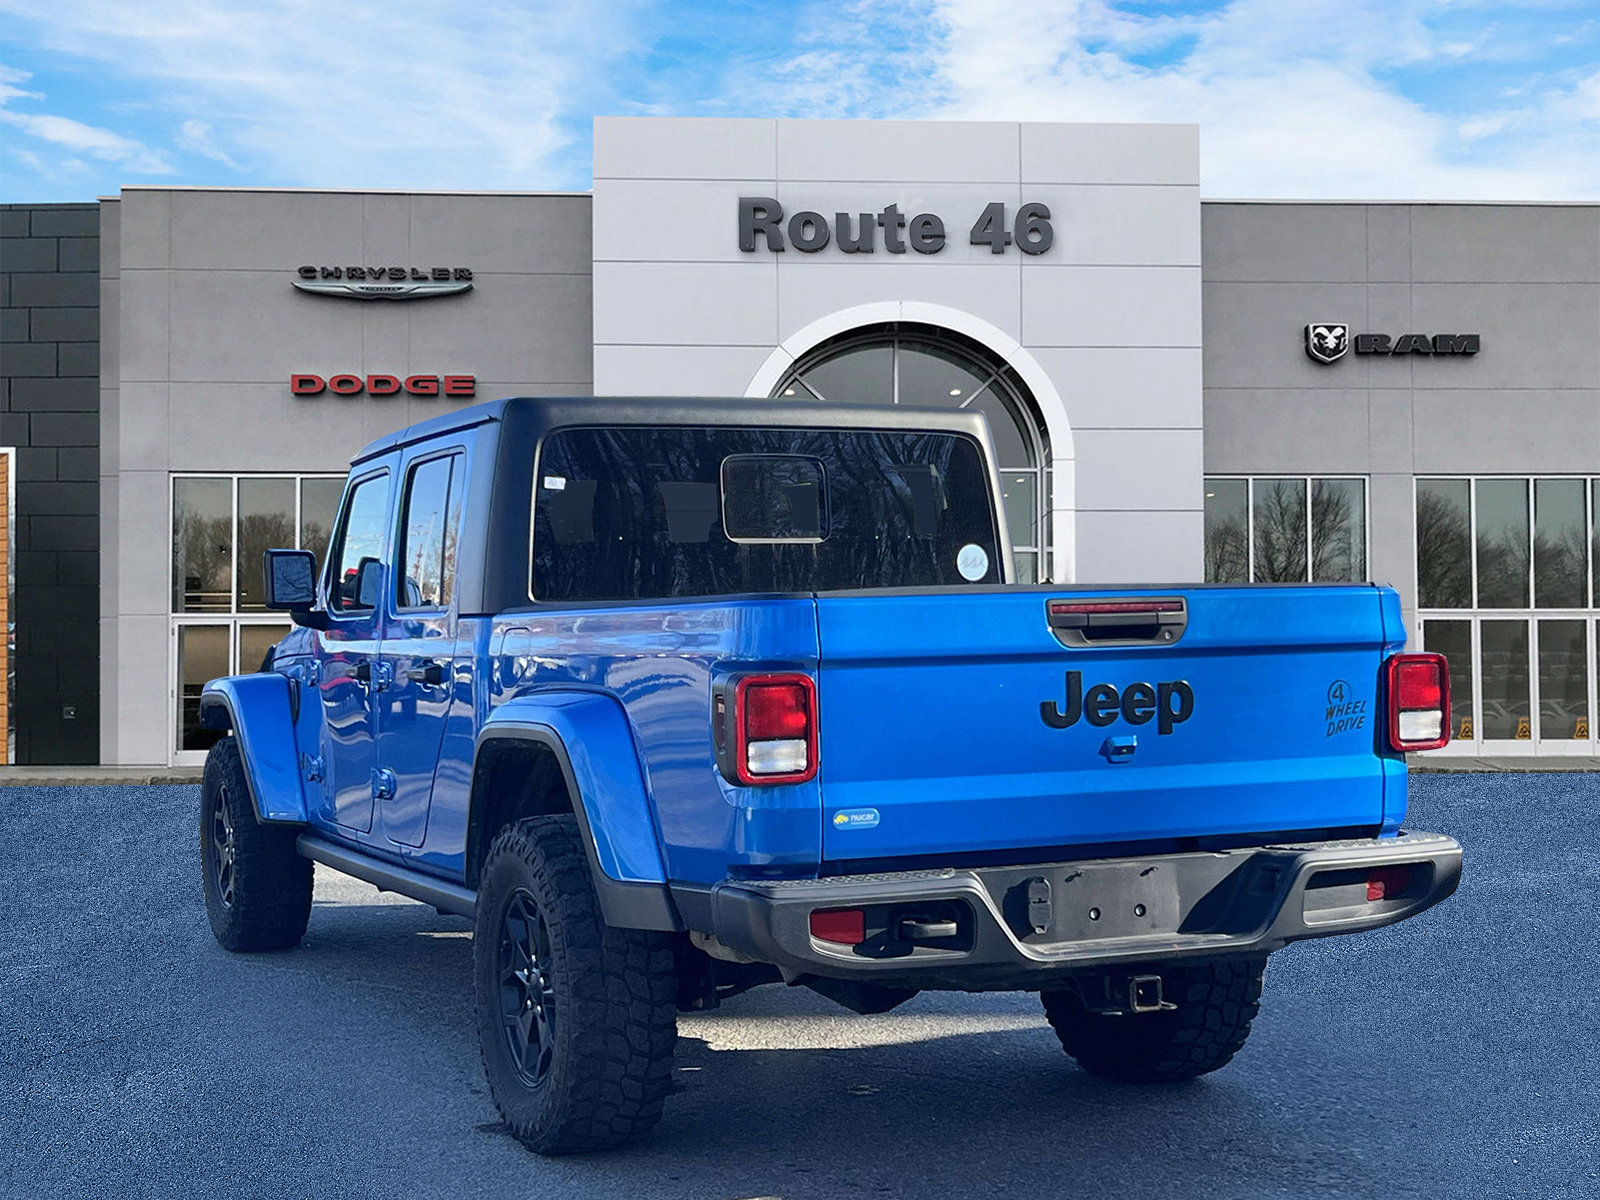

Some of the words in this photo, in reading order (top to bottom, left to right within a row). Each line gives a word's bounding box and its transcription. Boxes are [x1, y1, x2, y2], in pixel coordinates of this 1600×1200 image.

[738, 197, 946, 253] Route
[970, 202, 1054, 255] 46
[298, 266, 473, 281] CHRYSLER
[1354, 334, 1481, 356] RAM
[291, 374, 476, 397] DODGE
[1039, 671, 1194, 735] Jeep
[1332, 683, 1344, 702] 4
[1326, 700, 1366, 721] WHEEL
[1326, 716, 1365, 738] DRIVE
[850, 814, 875, 822] nucar
